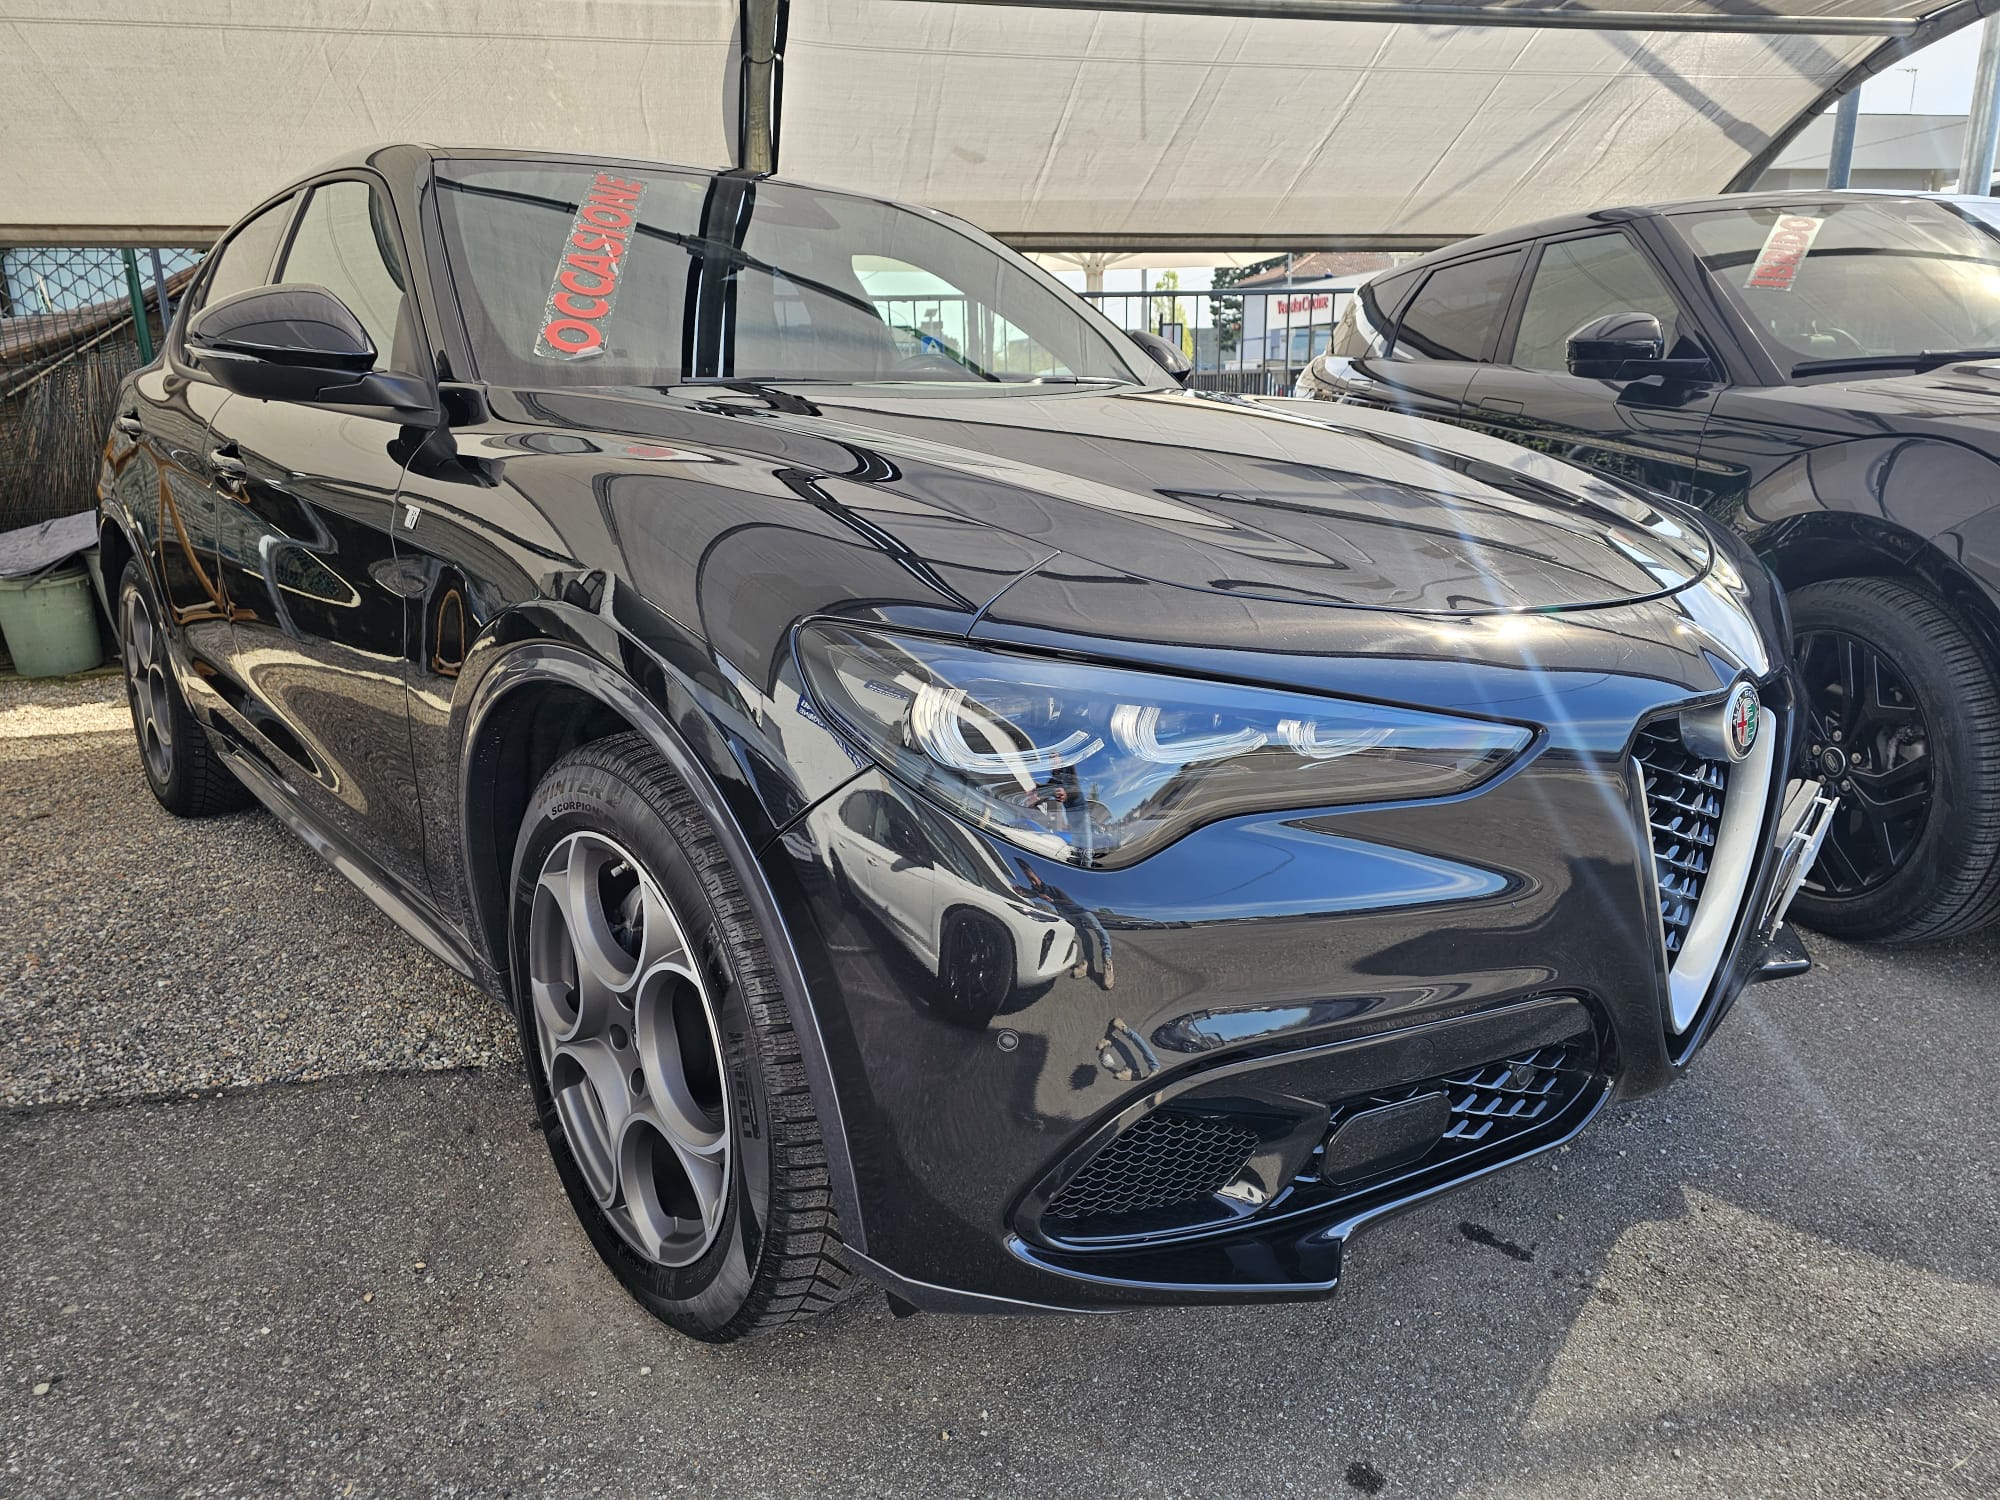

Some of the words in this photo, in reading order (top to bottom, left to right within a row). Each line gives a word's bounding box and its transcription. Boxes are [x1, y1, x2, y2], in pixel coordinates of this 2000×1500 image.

[545, 174, 642, 354] OCCASIONE
[1750, 218, 1817, 287] IBRIDO
[538, 777, 604, 809] WINTER
[551, 802, 602, 817] SCORPION
